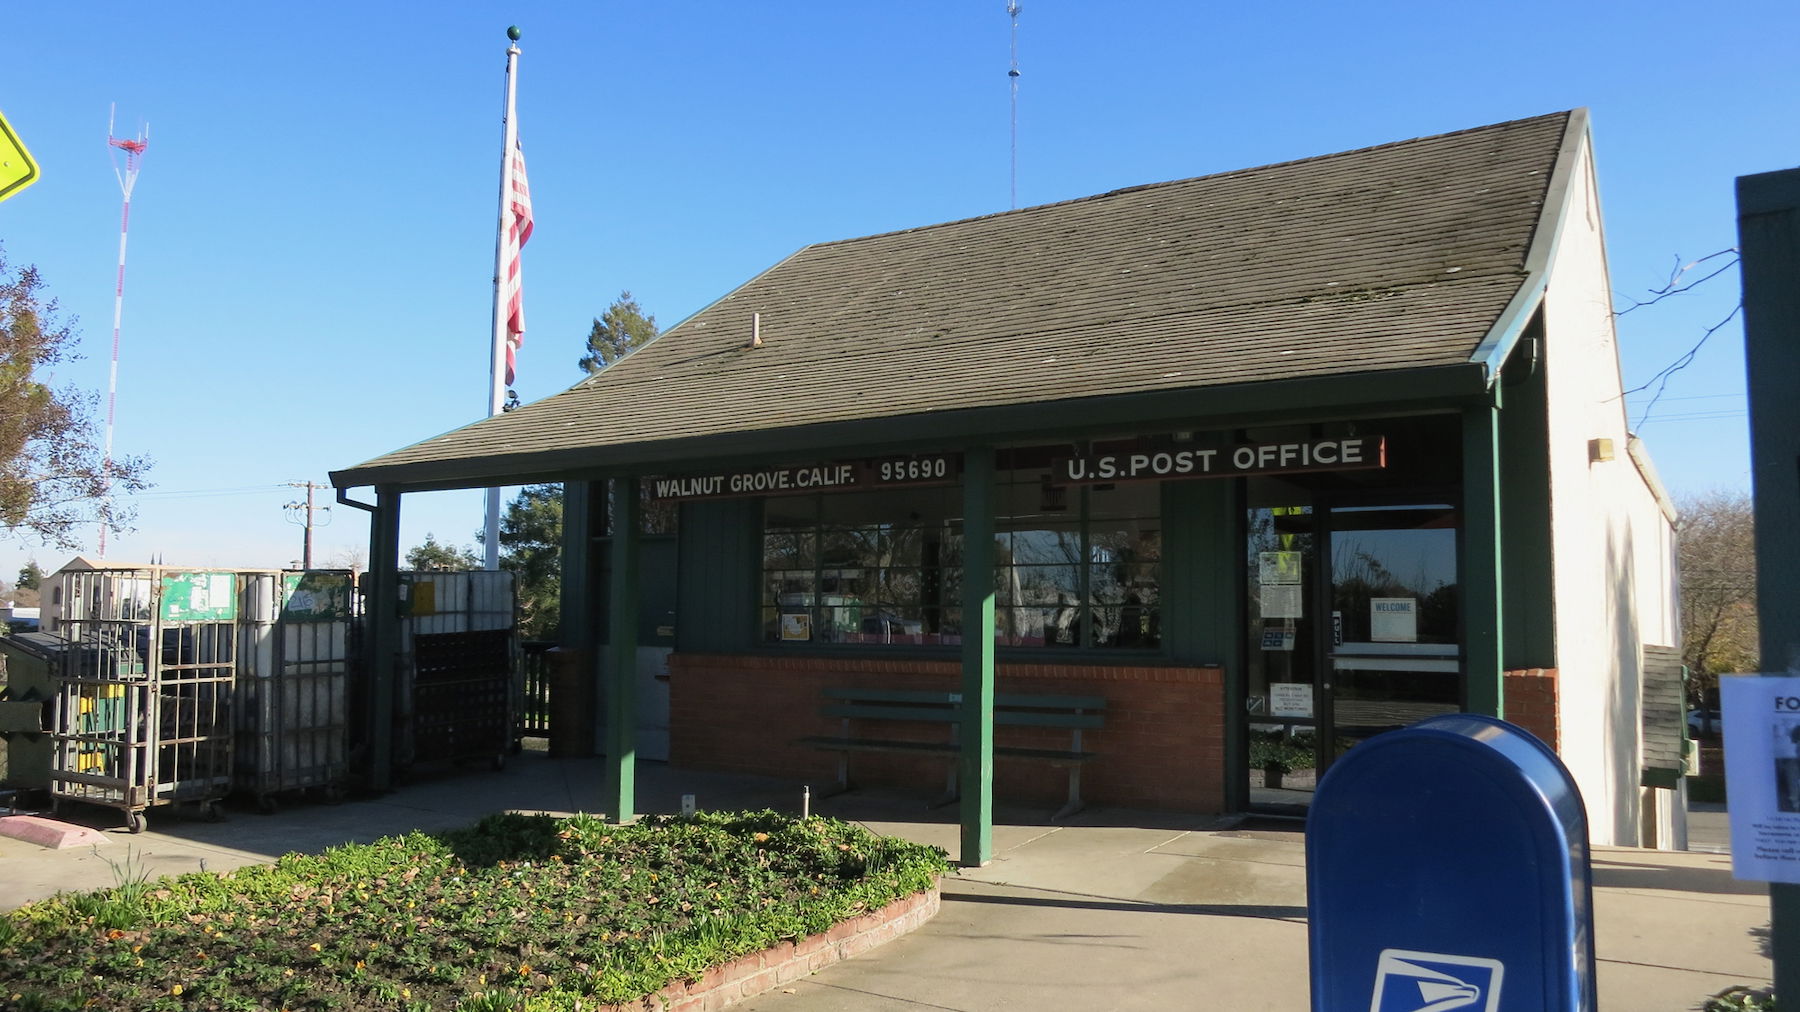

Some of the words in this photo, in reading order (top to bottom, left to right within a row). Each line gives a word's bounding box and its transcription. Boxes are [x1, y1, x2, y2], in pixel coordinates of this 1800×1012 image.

[1233, 439, 1363, 470] OFFICE
[656, 475, 724, 498] WALNUT
[881, 458, 946, 481] 95690
[1375, 602, 1412, 612] WELCOME
